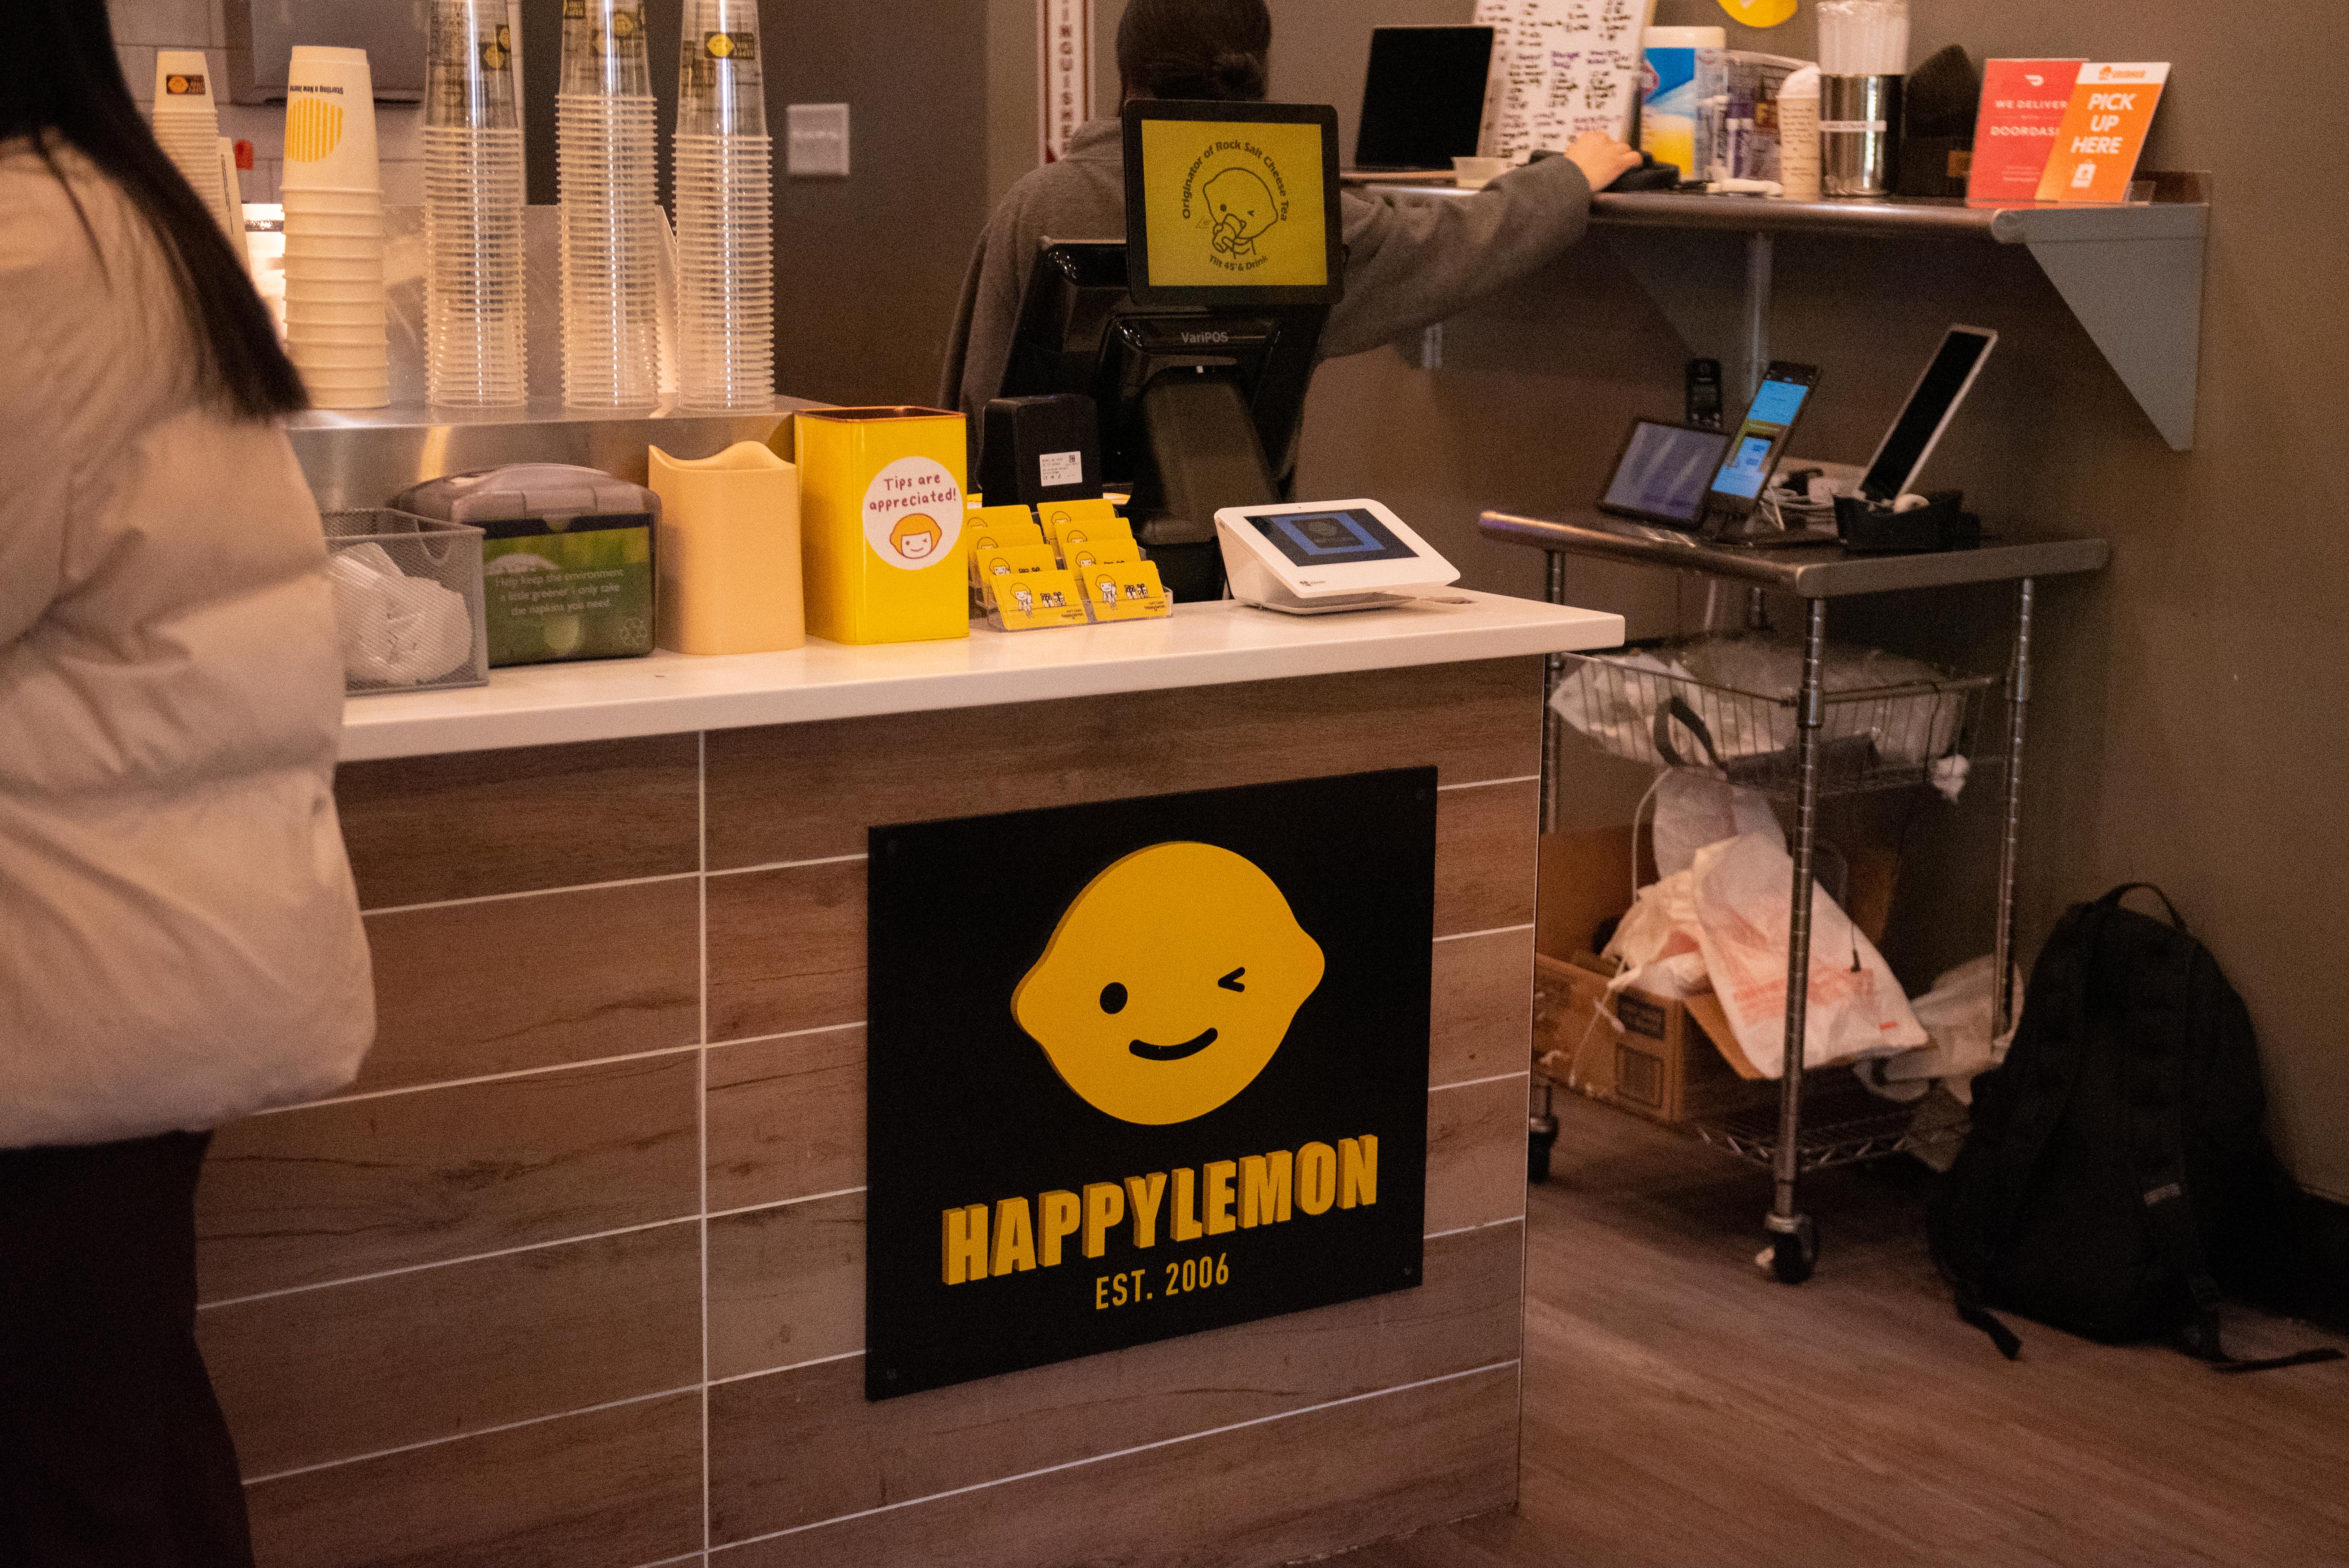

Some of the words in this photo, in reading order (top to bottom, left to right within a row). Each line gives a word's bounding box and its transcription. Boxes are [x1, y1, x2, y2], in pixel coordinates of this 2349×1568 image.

[320, 85, 343, 95] Starting
[1995, 100, 2013, 108] WE
[2017, 100, 2067, 110] DELIVER
[2087, 93, 2137, 110] PICK
[2090, 114, 2120, 132] UP
[2071, 136, 2123, 154] HERE
[1182, 158, 1203, 219] Originator
[1203, 145, 1214, 158] of
[1216, 140, 1241, 153] Rock
[1243, 142, 1263, 159] Salt
[1263, 156, 1286, 196] Cheese
[1280, 200, 1289, 221] Tea
[1210, 255, 1222, 268] Tilt
[1246, 255, 1268, 269] Drink
[1181, 331, 1229, 343] VariPOS
[884, 476, 912, 491] Tips
[918, 474, 940, 485] are
[870, 488, 956, 512] appreciated!
[496, 576, 519, 588] Help
[521, 575, 544, 586] keep
[546, 574, 562, 582] the
[565, 569, 623, 580] environment
[578, 584, 597, 596] only
[601, 583, 620, 592] take
[511, 606, 527, 615] the
[529, 602, 564, 614] napkins
[567, 601, 584, 611] you
[942, 1134, 1379, 1286] HAPPYLEMON
[1095, 1269, 1153, 1310] EST.
[1167, 1252, 1229, 1296] 2006
